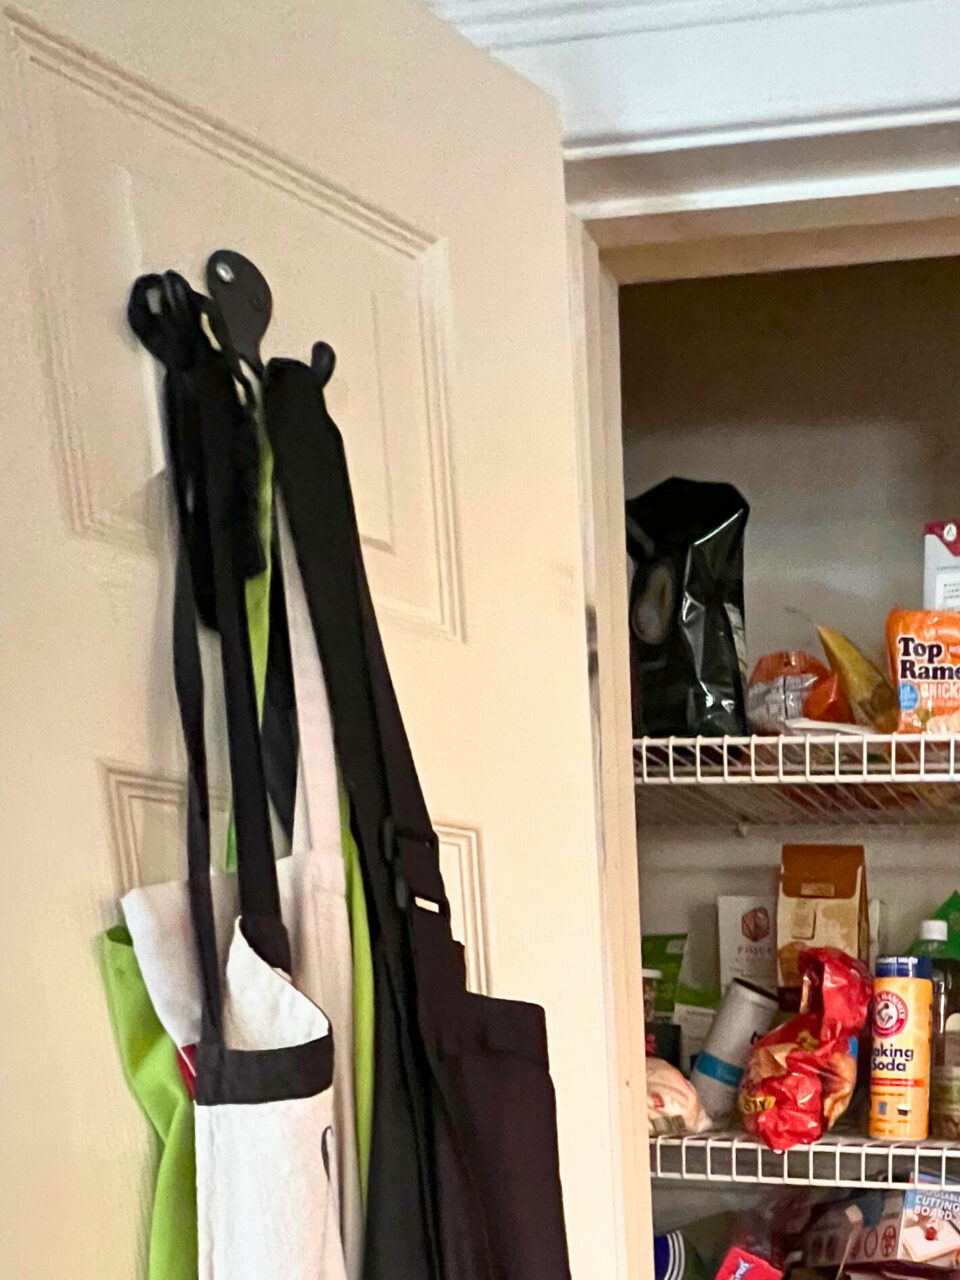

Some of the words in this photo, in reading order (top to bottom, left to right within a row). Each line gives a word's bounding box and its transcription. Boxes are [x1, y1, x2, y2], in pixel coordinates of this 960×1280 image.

[898, 637, 943, 663] Top
[872, 1043, 914, 1062] aking
[913, 1204, 953, 1221] BOARD
[915, 1195, 960, 1212] CUTTING
